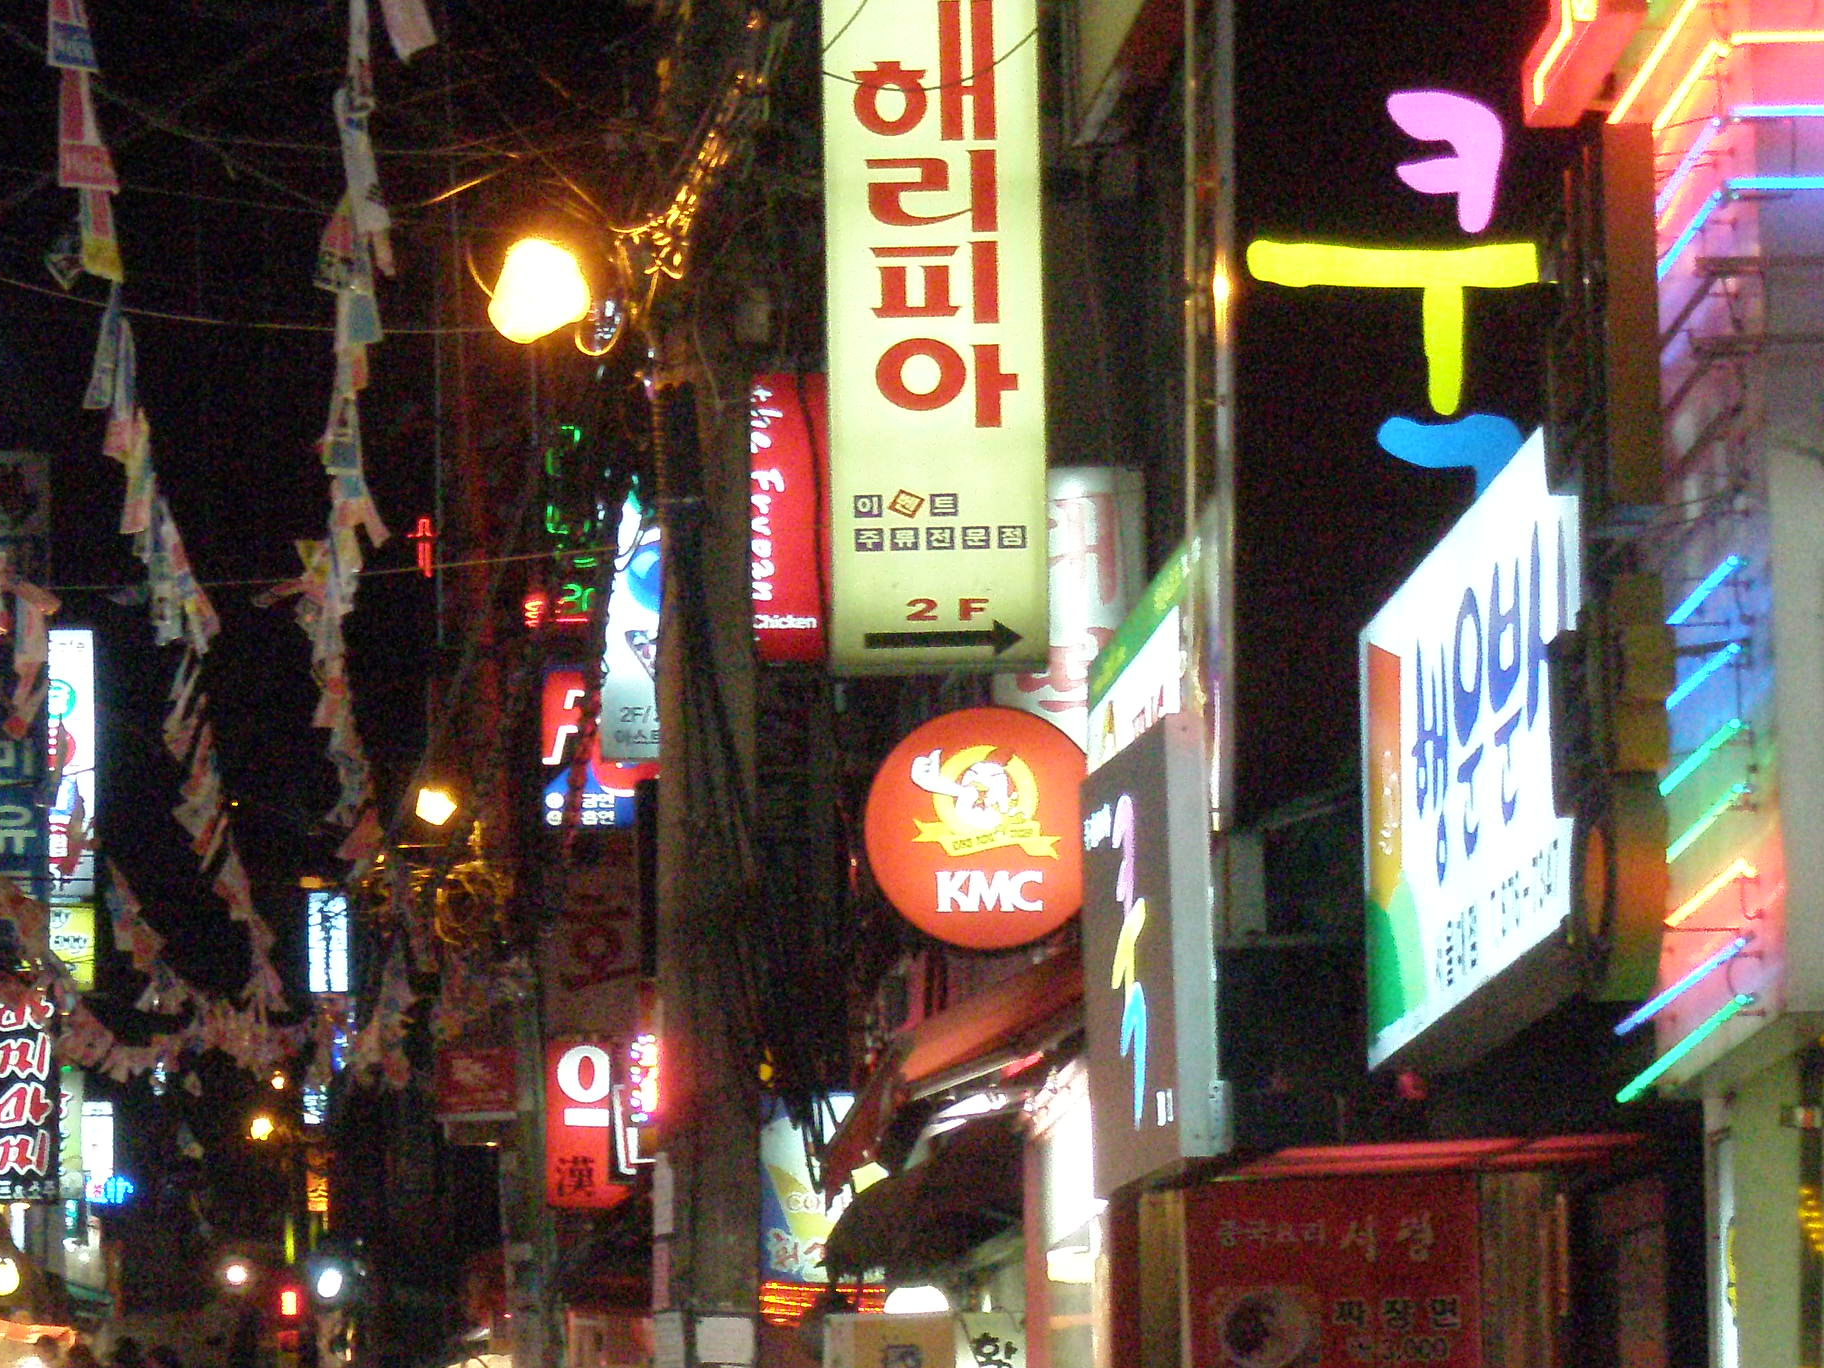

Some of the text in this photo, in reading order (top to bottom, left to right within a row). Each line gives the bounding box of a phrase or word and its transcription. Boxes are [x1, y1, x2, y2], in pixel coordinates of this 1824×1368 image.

[852, 0, 1018, 428] 해리피아
[854, 488, 959, 518] 이벤트
[854, 525, 1027, 551] 주류전문점
[935, 870, 1044, 912] KMC
